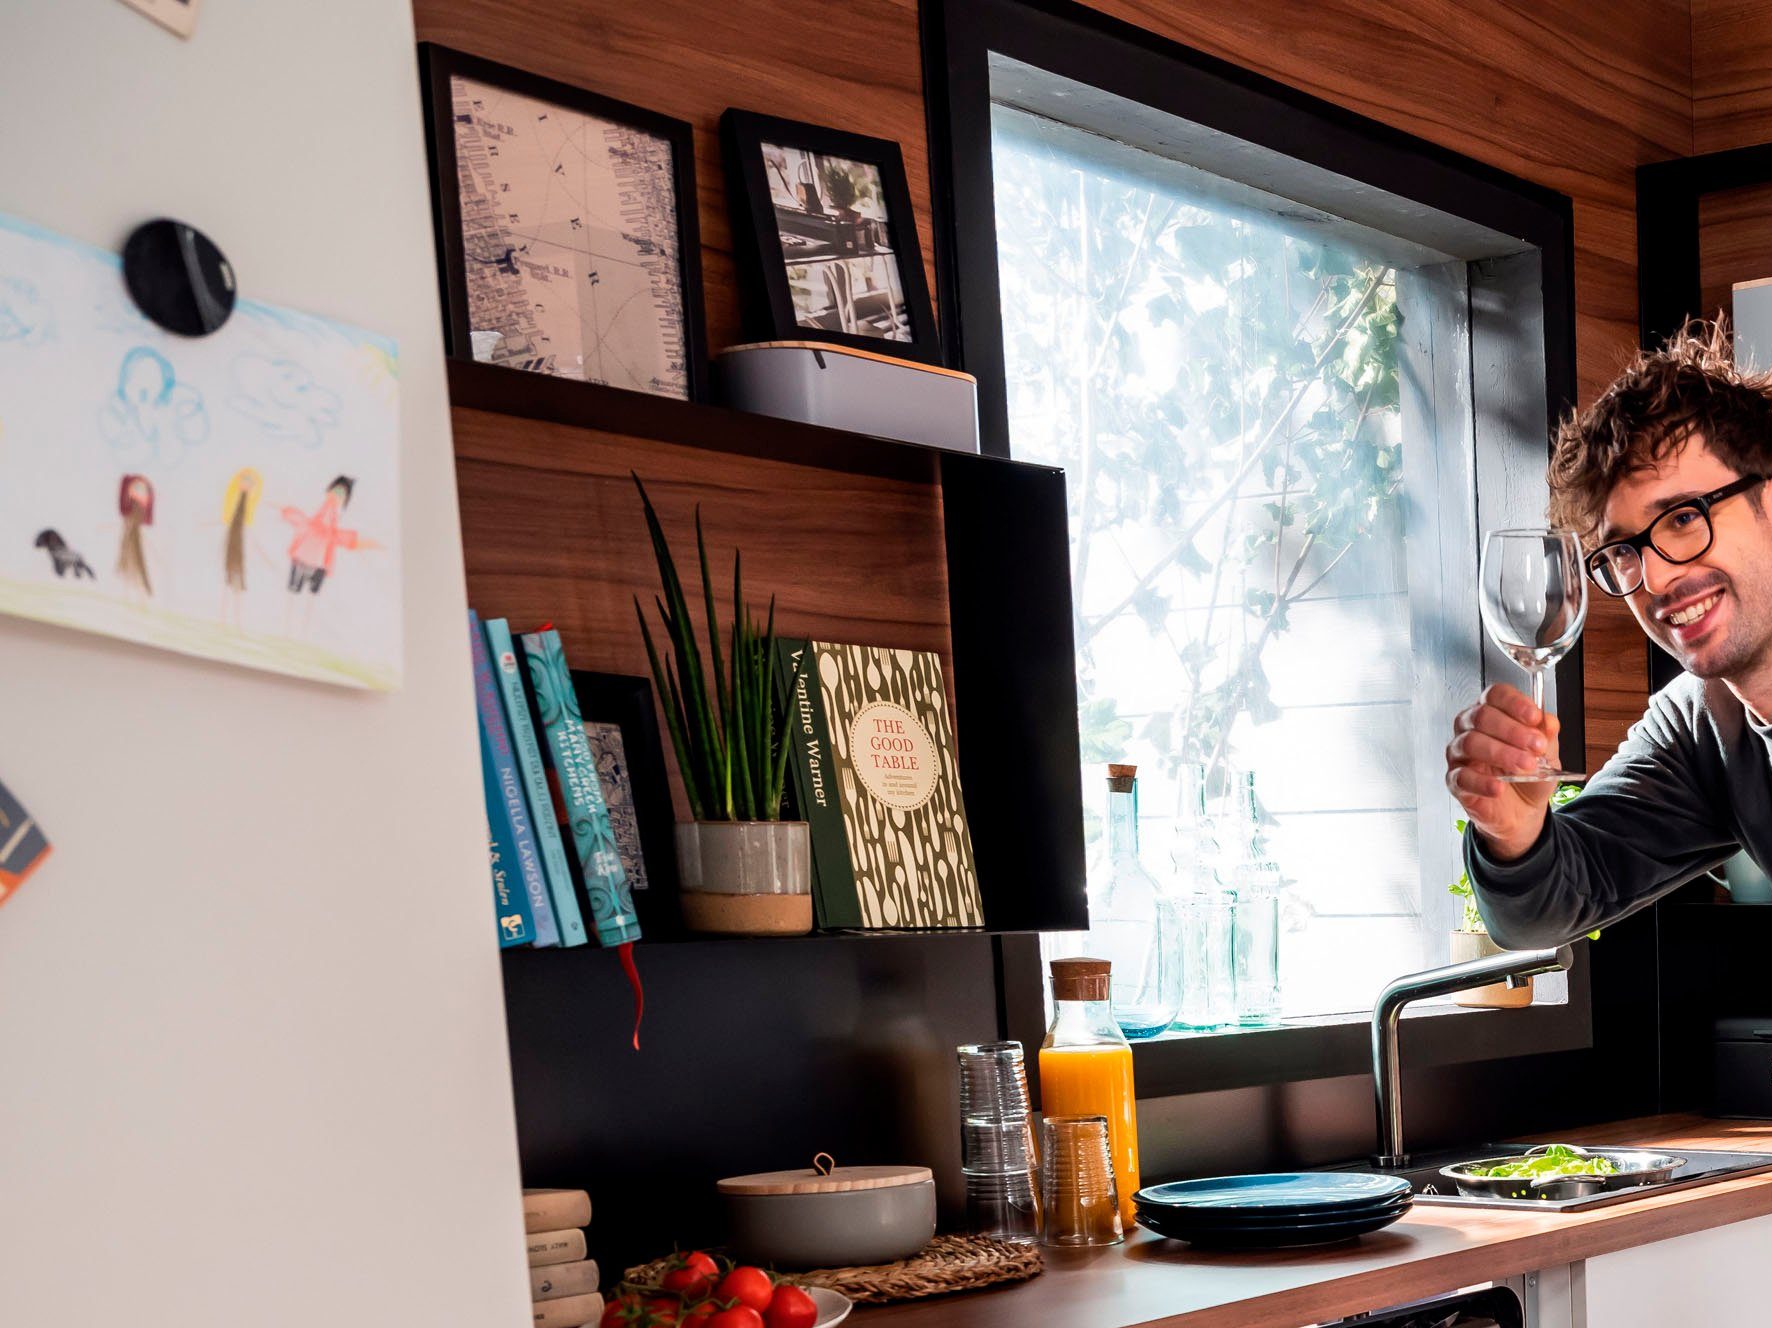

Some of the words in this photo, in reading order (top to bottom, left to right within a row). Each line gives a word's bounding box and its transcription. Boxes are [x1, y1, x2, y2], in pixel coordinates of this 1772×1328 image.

[564, 720, 585, 763] MANY
[871, 736, 913, 752] GOOD
[873, 719, 905, 734] THE
[558, 731, 585, 806] KITCHENS
[807, 739, 827, 807] Warner
[871, 754, 919, 770] TABLE
[501, 767, 526, 834] NIGELLA
[518, 840, 544, 908] LAWSON
